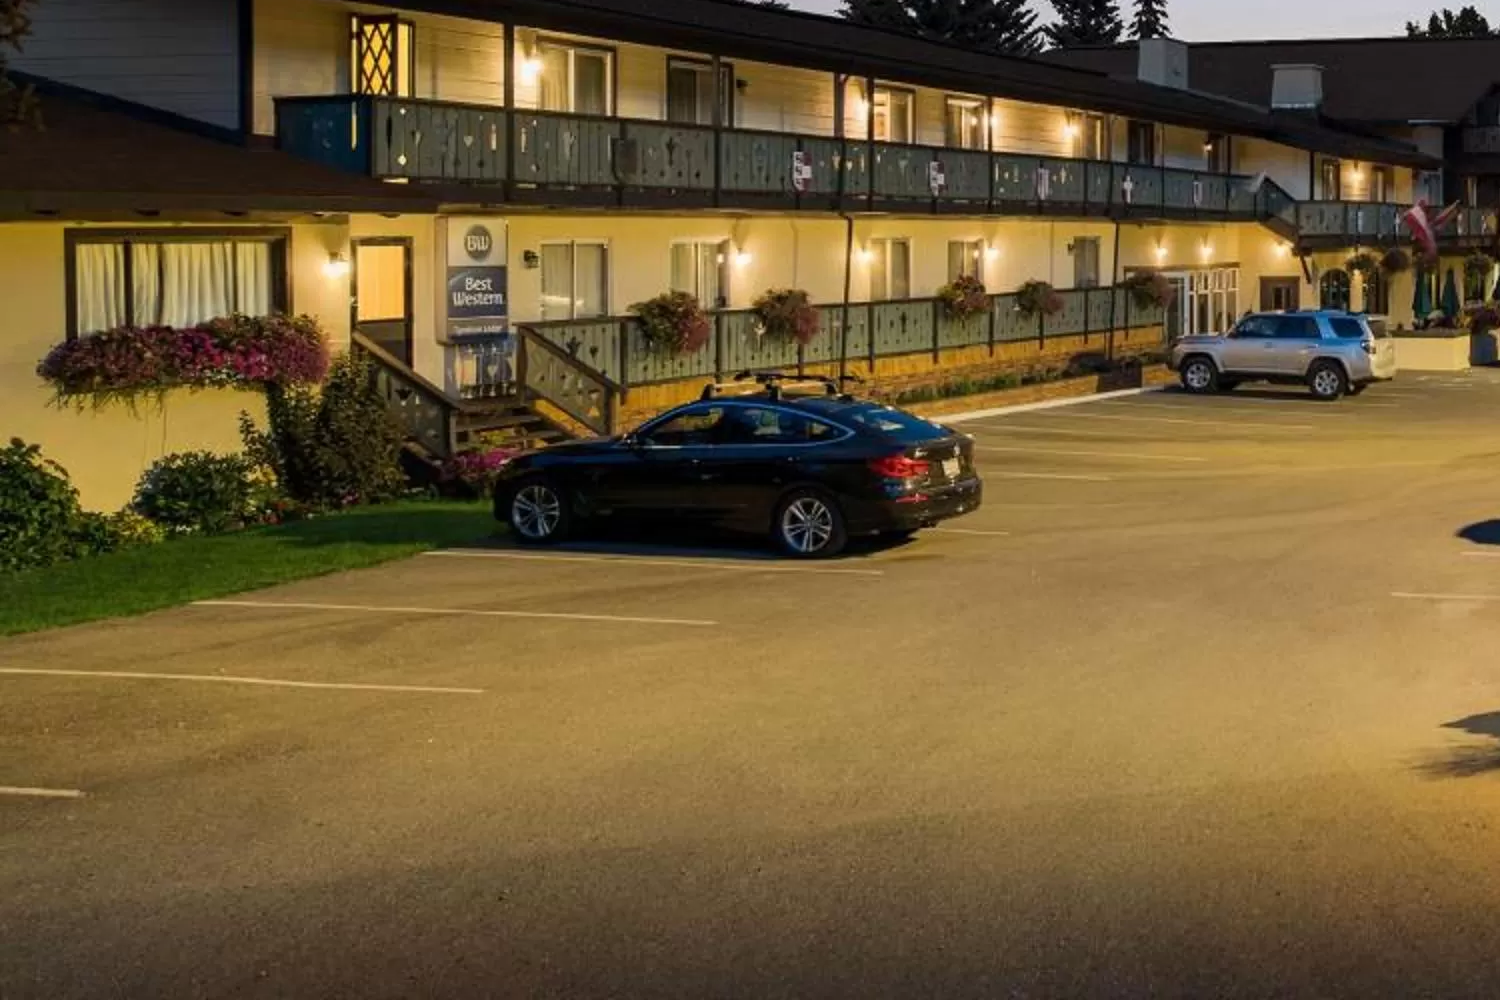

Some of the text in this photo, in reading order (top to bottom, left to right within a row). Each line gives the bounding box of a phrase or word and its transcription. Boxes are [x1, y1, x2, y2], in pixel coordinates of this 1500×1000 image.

[467, 235, 489, 250] BW
[465, 277, 492, 291] Best
[453, 292, 503, 306] Western
